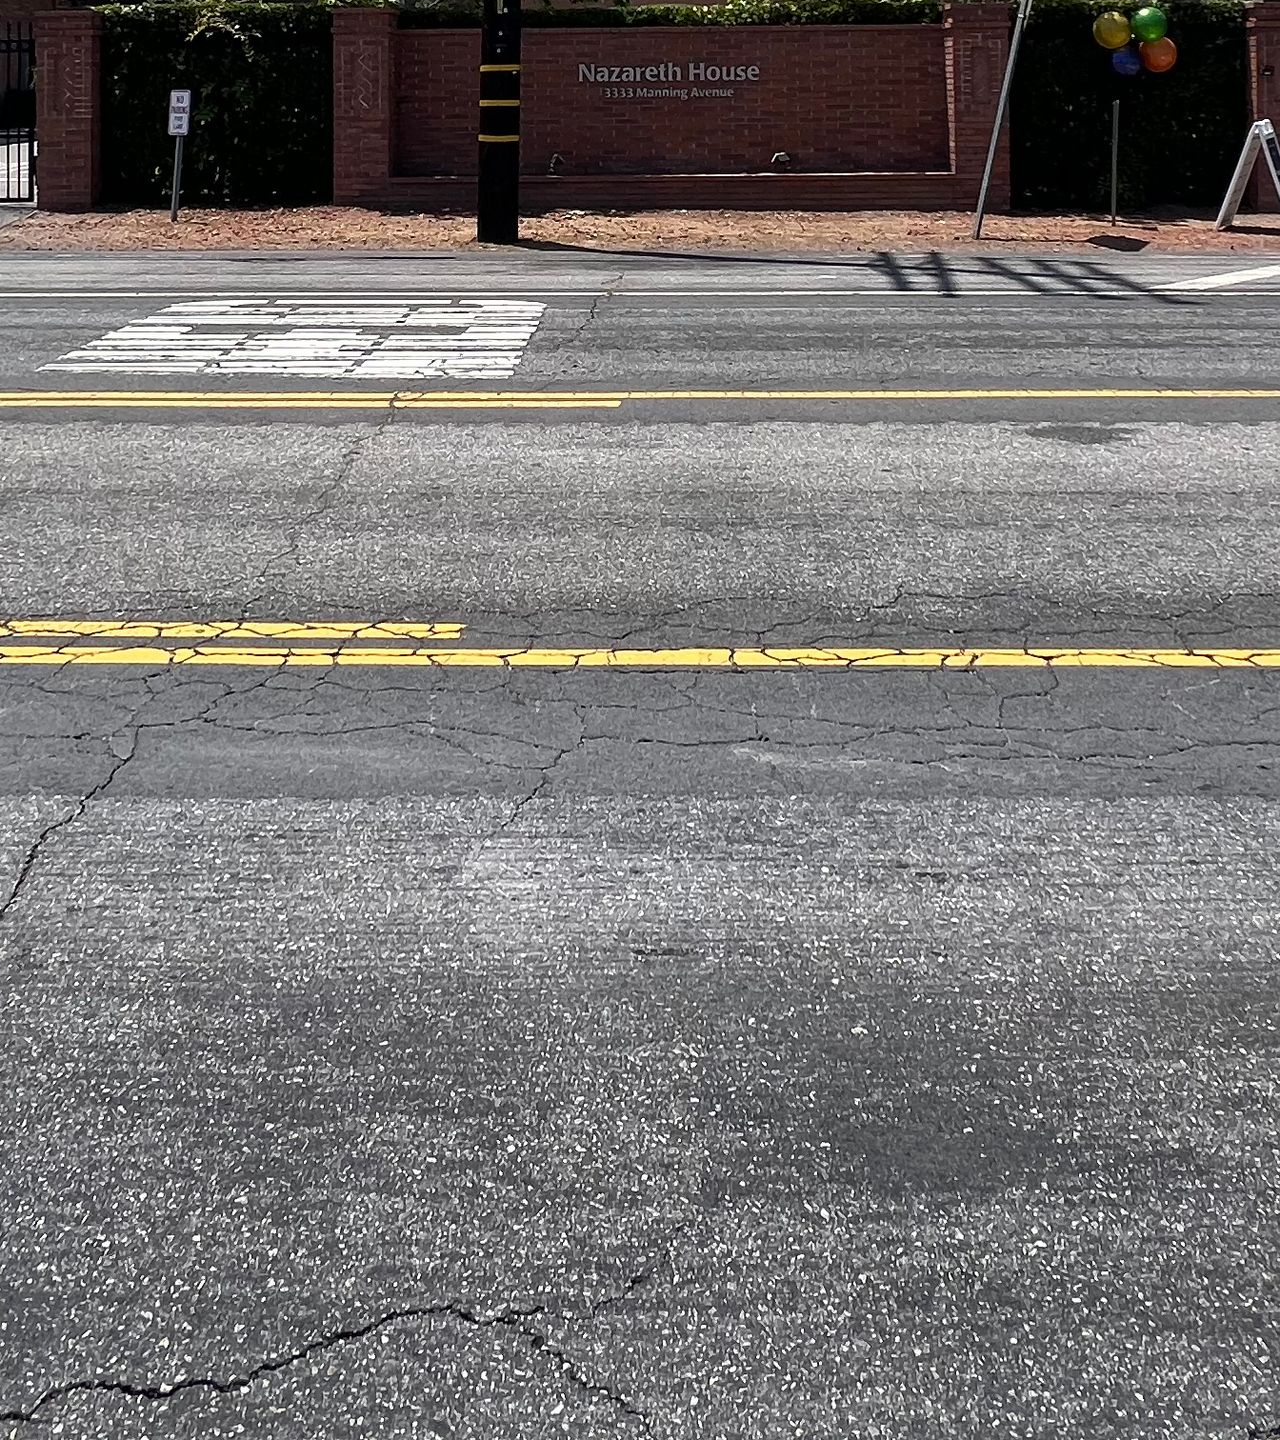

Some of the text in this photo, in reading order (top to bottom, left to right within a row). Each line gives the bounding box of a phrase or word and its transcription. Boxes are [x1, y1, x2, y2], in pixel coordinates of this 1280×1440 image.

[578, 62, 760, 82] Nazareth House
[604, 87, 735, 100] 3333 Manning Avenue
